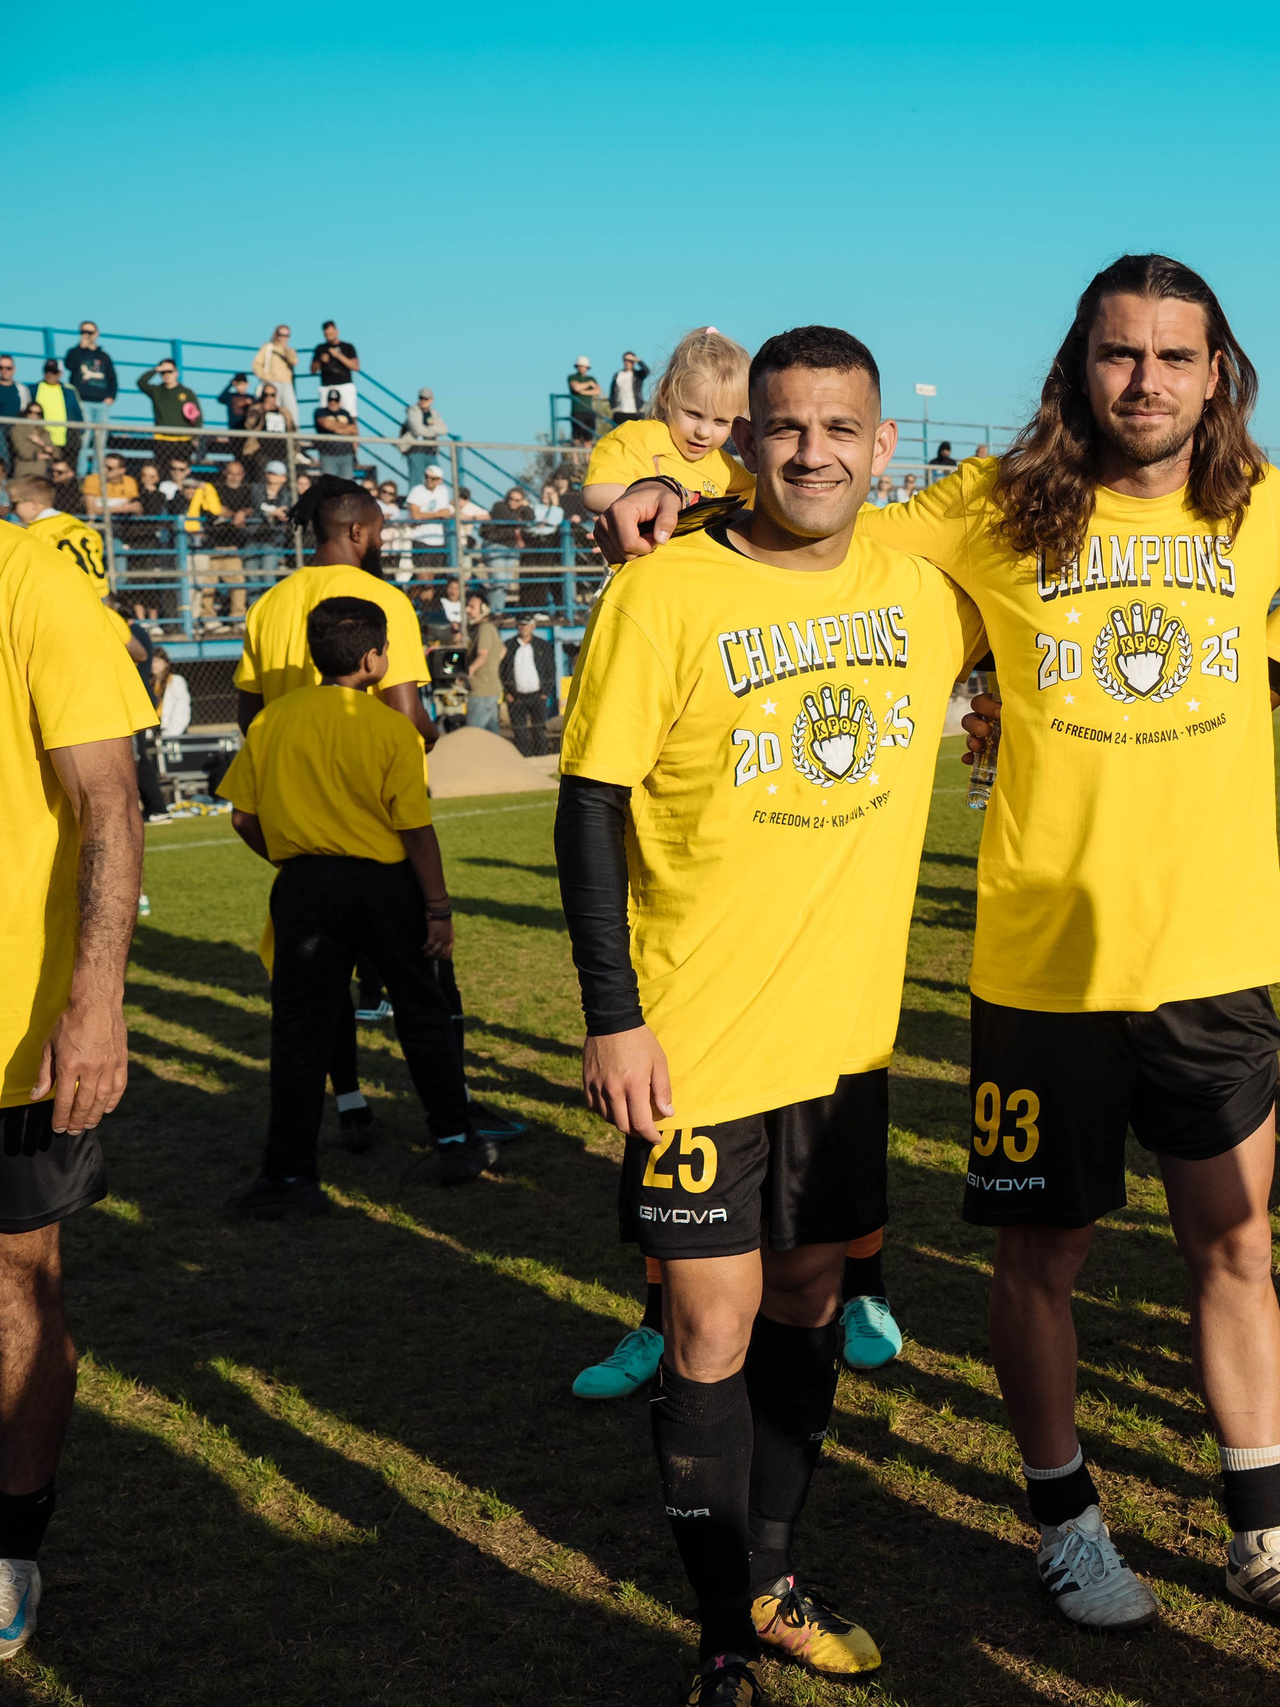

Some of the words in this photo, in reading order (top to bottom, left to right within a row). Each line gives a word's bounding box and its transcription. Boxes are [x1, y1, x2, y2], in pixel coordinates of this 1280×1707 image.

[717, 604, 910, 699] CHAMPIONS
[1035, 632, 1083, 690] 20
[1200, 626, 1240, 683] 25
[731, 727, 783, 788] 20
[880, 694, 915, 749] 25
[1050, 717, 1065, 732] FC
[1065, 723, 1113, 744] FREEDOM
[1114, 732, 1127, 744] 24
[1135, 728, 1179, 745] KRASAVA
[1185, 712, 1227, 738] YPSONAS
[752, 810, 767, 824] FC
[766, 812, 810, 828] REEDOM
[813, 816, 826, 829] 24
[973, 1081, 1041, 1163] 93
[642, 1127, 719, 1194] 25
[966, 1171, 1046, 1192] GIVOVA
[639, 1204, 728, 1225] GIVOVA
